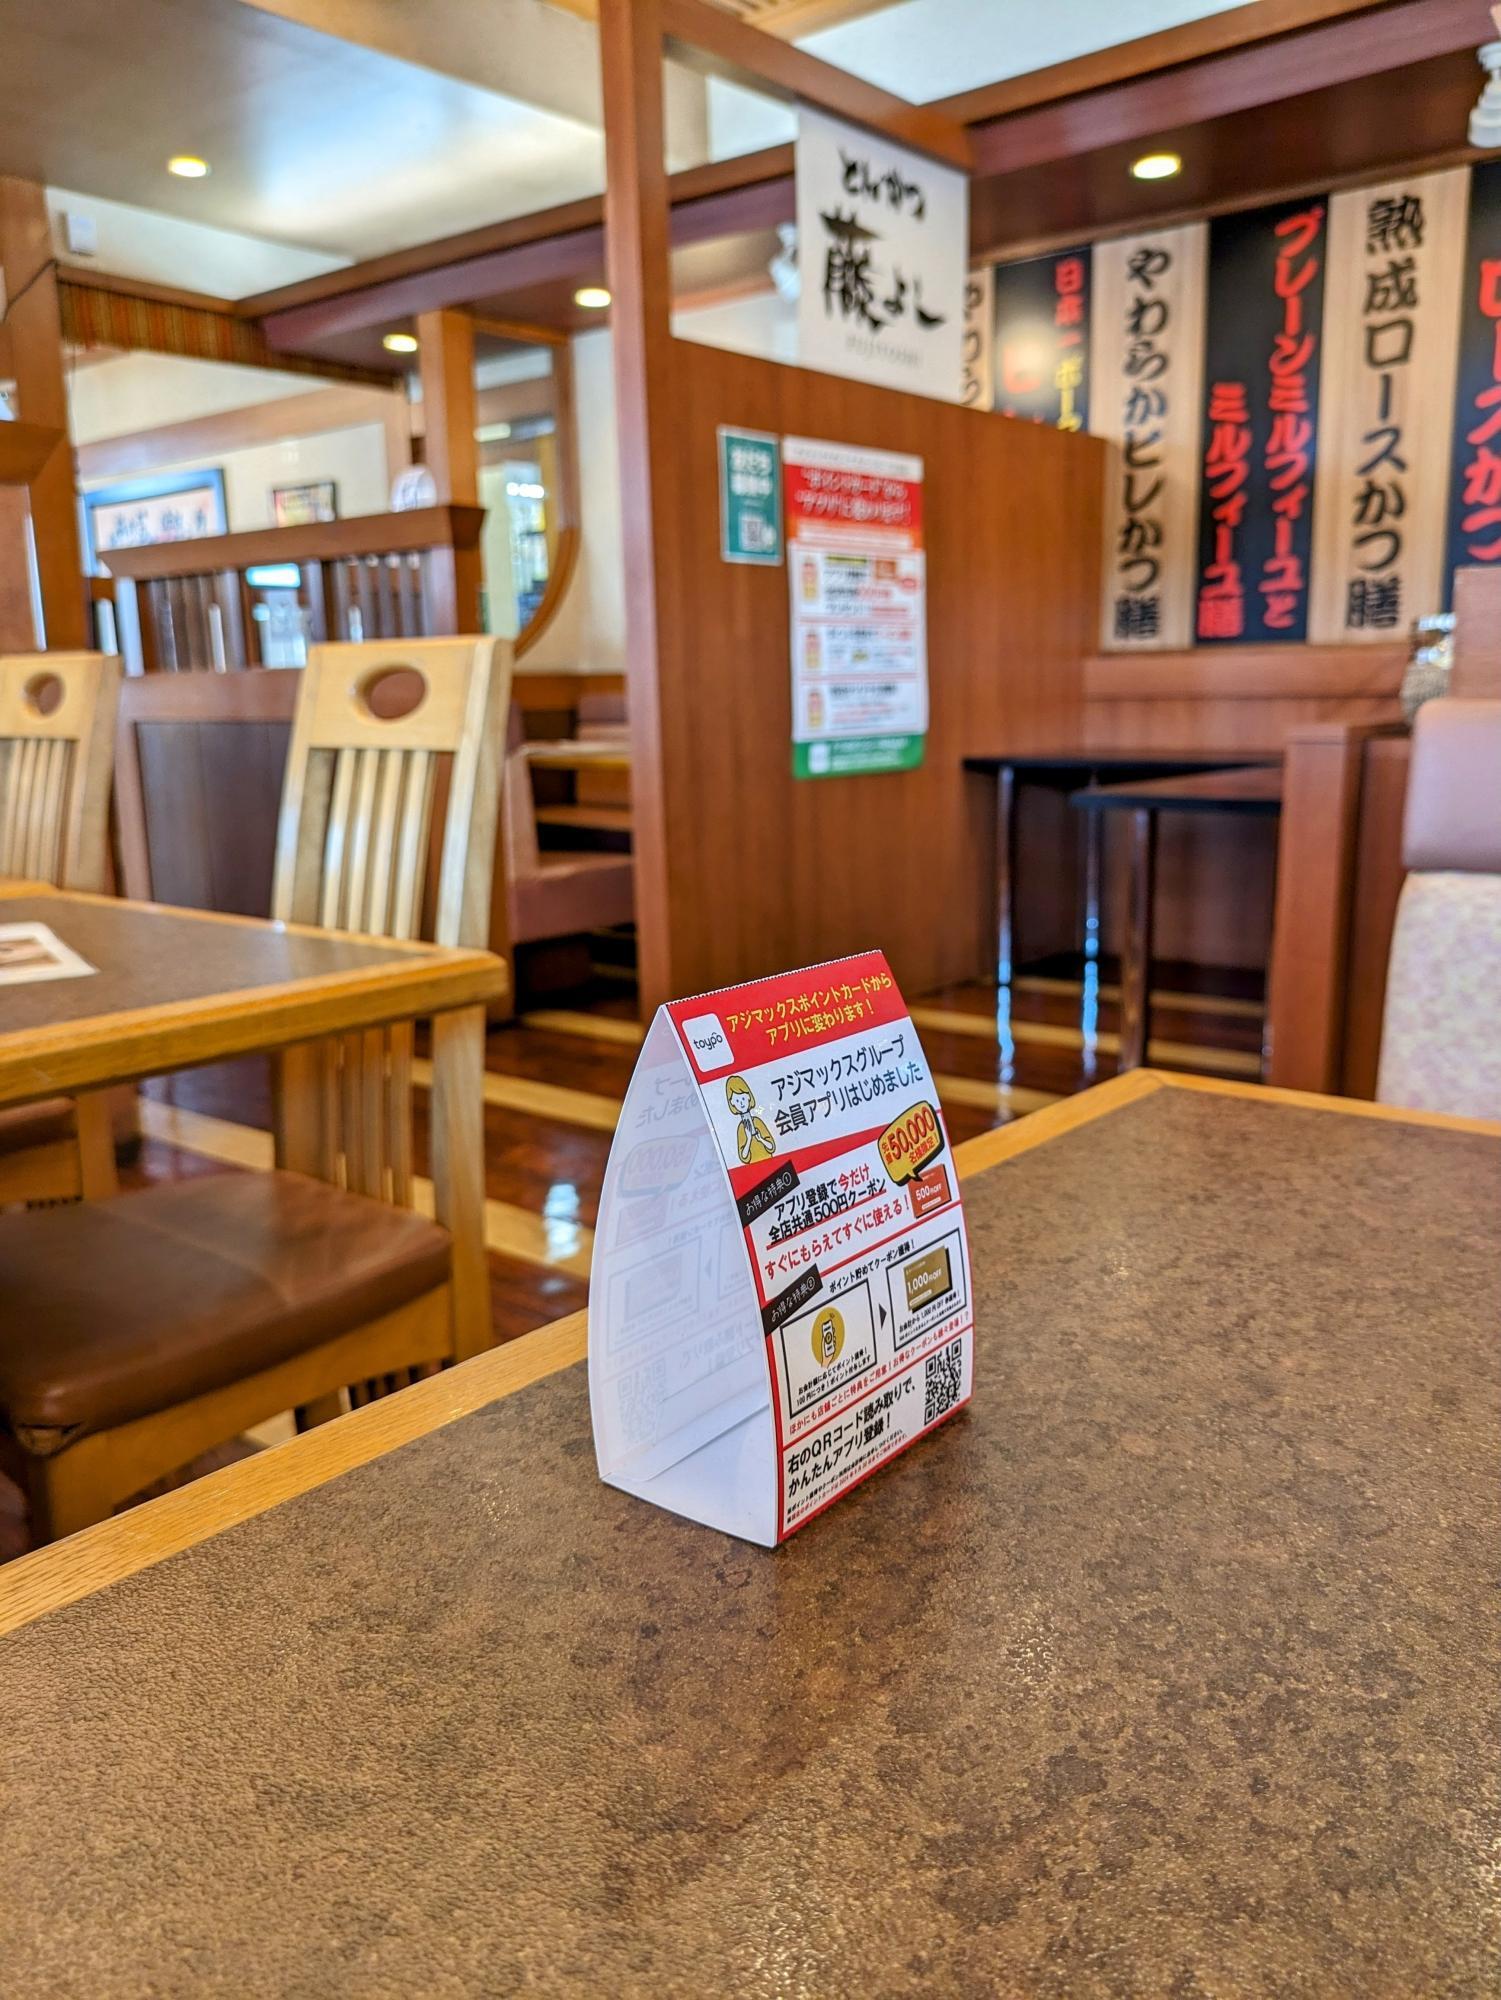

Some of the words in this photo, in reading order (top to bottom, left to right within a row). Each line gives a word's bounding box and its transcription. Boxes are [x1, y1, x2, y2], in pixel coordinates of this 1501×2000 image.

[839, 148, 925, 220] とんかつ
[818, 204, 946, 333] 藤よし
[1114, 246, 1171, 640] やわらかヒレかつ膳
[1262, 205, 1325, 629] プレーンミルフィーユと
[1346, 196, 1428, 631] 熟成ロースかつ膳
[725, 972, 893, 1033] アジマックスポイントカードから
[766, 1003, 875, 1047] アプリに変わります！
[771, 1034, 905, 1102] アジマックスグループ
[773, 1060, 924, 1137] 会員アプリはじめました
[887, 1106, 935, 1160] 50,000
[768, 1177, 887, 1246] 全店共通500円クーポン
[774, 1163, 871, 1221] アプリ登録で今だけ
[764, 1193, 910, 1280] すぐにもらえてすぐに使える！
[787, 1411, 892, 1499] かんたんアプリ登録！
